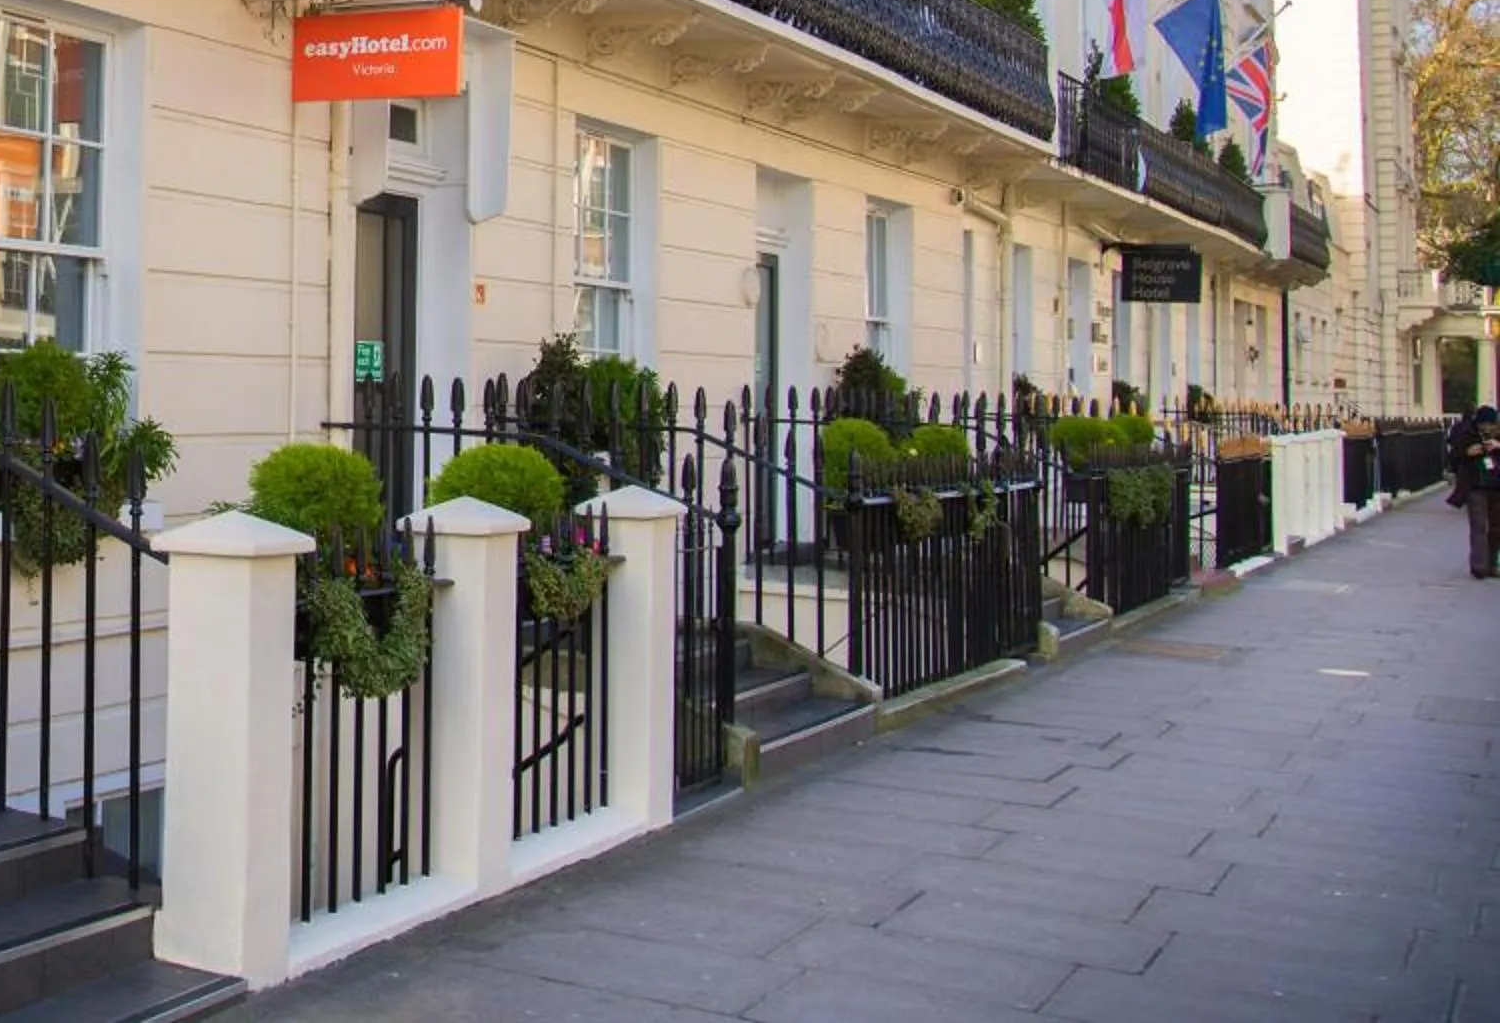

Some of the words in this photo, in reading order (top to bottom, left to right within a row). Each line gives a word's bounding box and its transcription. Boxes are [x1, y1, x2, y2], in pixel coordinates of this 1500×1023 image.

[304, 33, 448, 59] easyHotel.com
[353, 62, 396, 75] Victoria
[1132, 287, 1171, 299] Hotel
